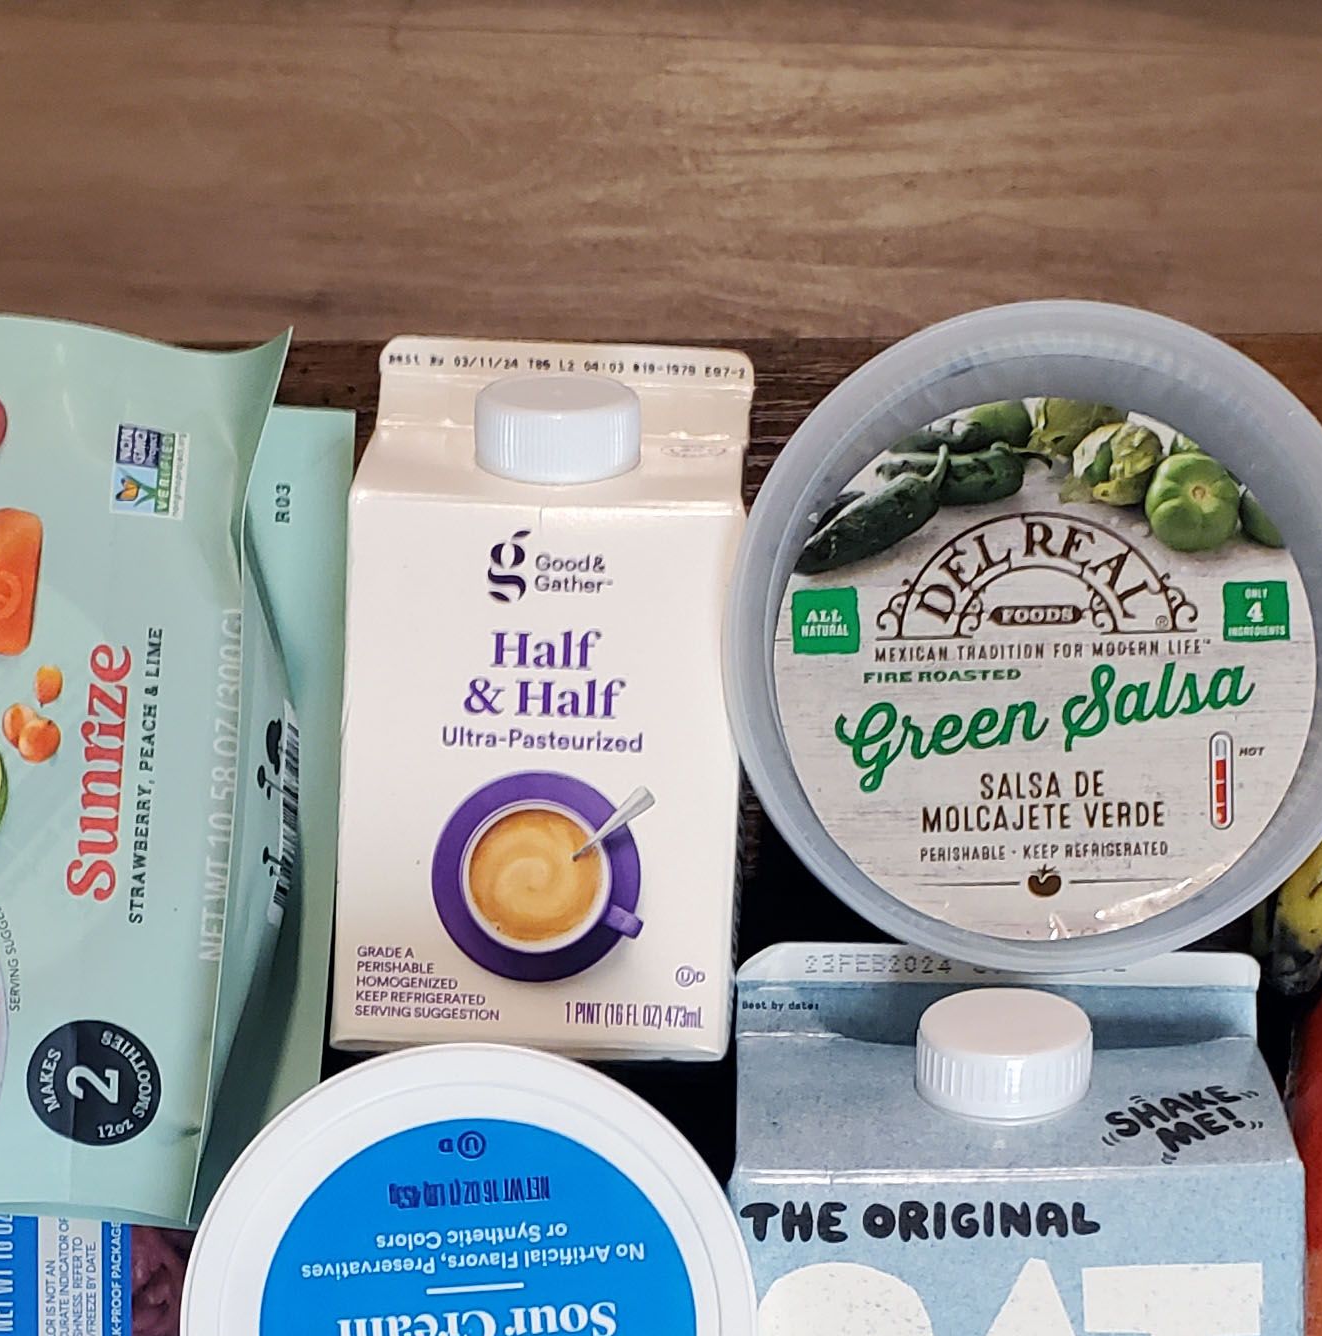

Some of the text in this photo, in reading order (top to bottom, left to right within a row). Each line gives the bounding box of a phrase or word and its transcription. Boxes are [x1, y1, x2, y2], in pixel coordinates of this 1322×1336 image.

[157, 436, 175, 511] VERIFIED
[275, 483, 292, 524] R03
[915, 517, 1157, 625] DEL REAL
[1243, 587, 1270, 600] ONLY
[799, 621, 850, 639] NATURAL
[490, 630, 602, 670] Half
[873, 639, 1161, 663] MEXICAN TRADITION MODERN
[862, 668, 1023, 685] FIRE ROASTED
[462, 676, 627, 719] & Half
[441, 726, 644, 754] Ultra-Pasteurized
[834, 660, 1257, 794] Green Salsa
[1238, 745, 1266, 758] HOT
[66, 643, 132, 902] Sunrize
[128, 627, 163, 925] STRAWBERRY, PEACH LIME
[979, 770, 1106, 800] SALSA DE
[921, 800, 1166, 836] MOLCAJETE VERDE
[918, 841, 1169, 863] PERISHABLE REFRIGERATED
[356, 960, 435, 975] PERISHABLE
[803, 953, 952, 976] 23FEB2024
[354, 1005, 501, 1022] SERVING SUGGESTION
[389, 991, 487, 1006] REFRIGERATED
[741, 999, 768, 1011] Best
[664, 1004, 705, 1030] 473mL
[39, 1048, 62, 1114] MAKES
[66, 1064, 120, 1105] 2
[100, 1029, 154, 1119] SMOOTHIES
[1104, 1085, 1241, 1137] SHAKE
[96, 1118, 135, 1139] 12oz
[375, 1223, 568, 1250] or Synthetic Colors
[739, 1200, 1102, 1243] THE ORIGINAL
[301, 1240, 645, 1280] No Artificial Flavors, Preservatives
